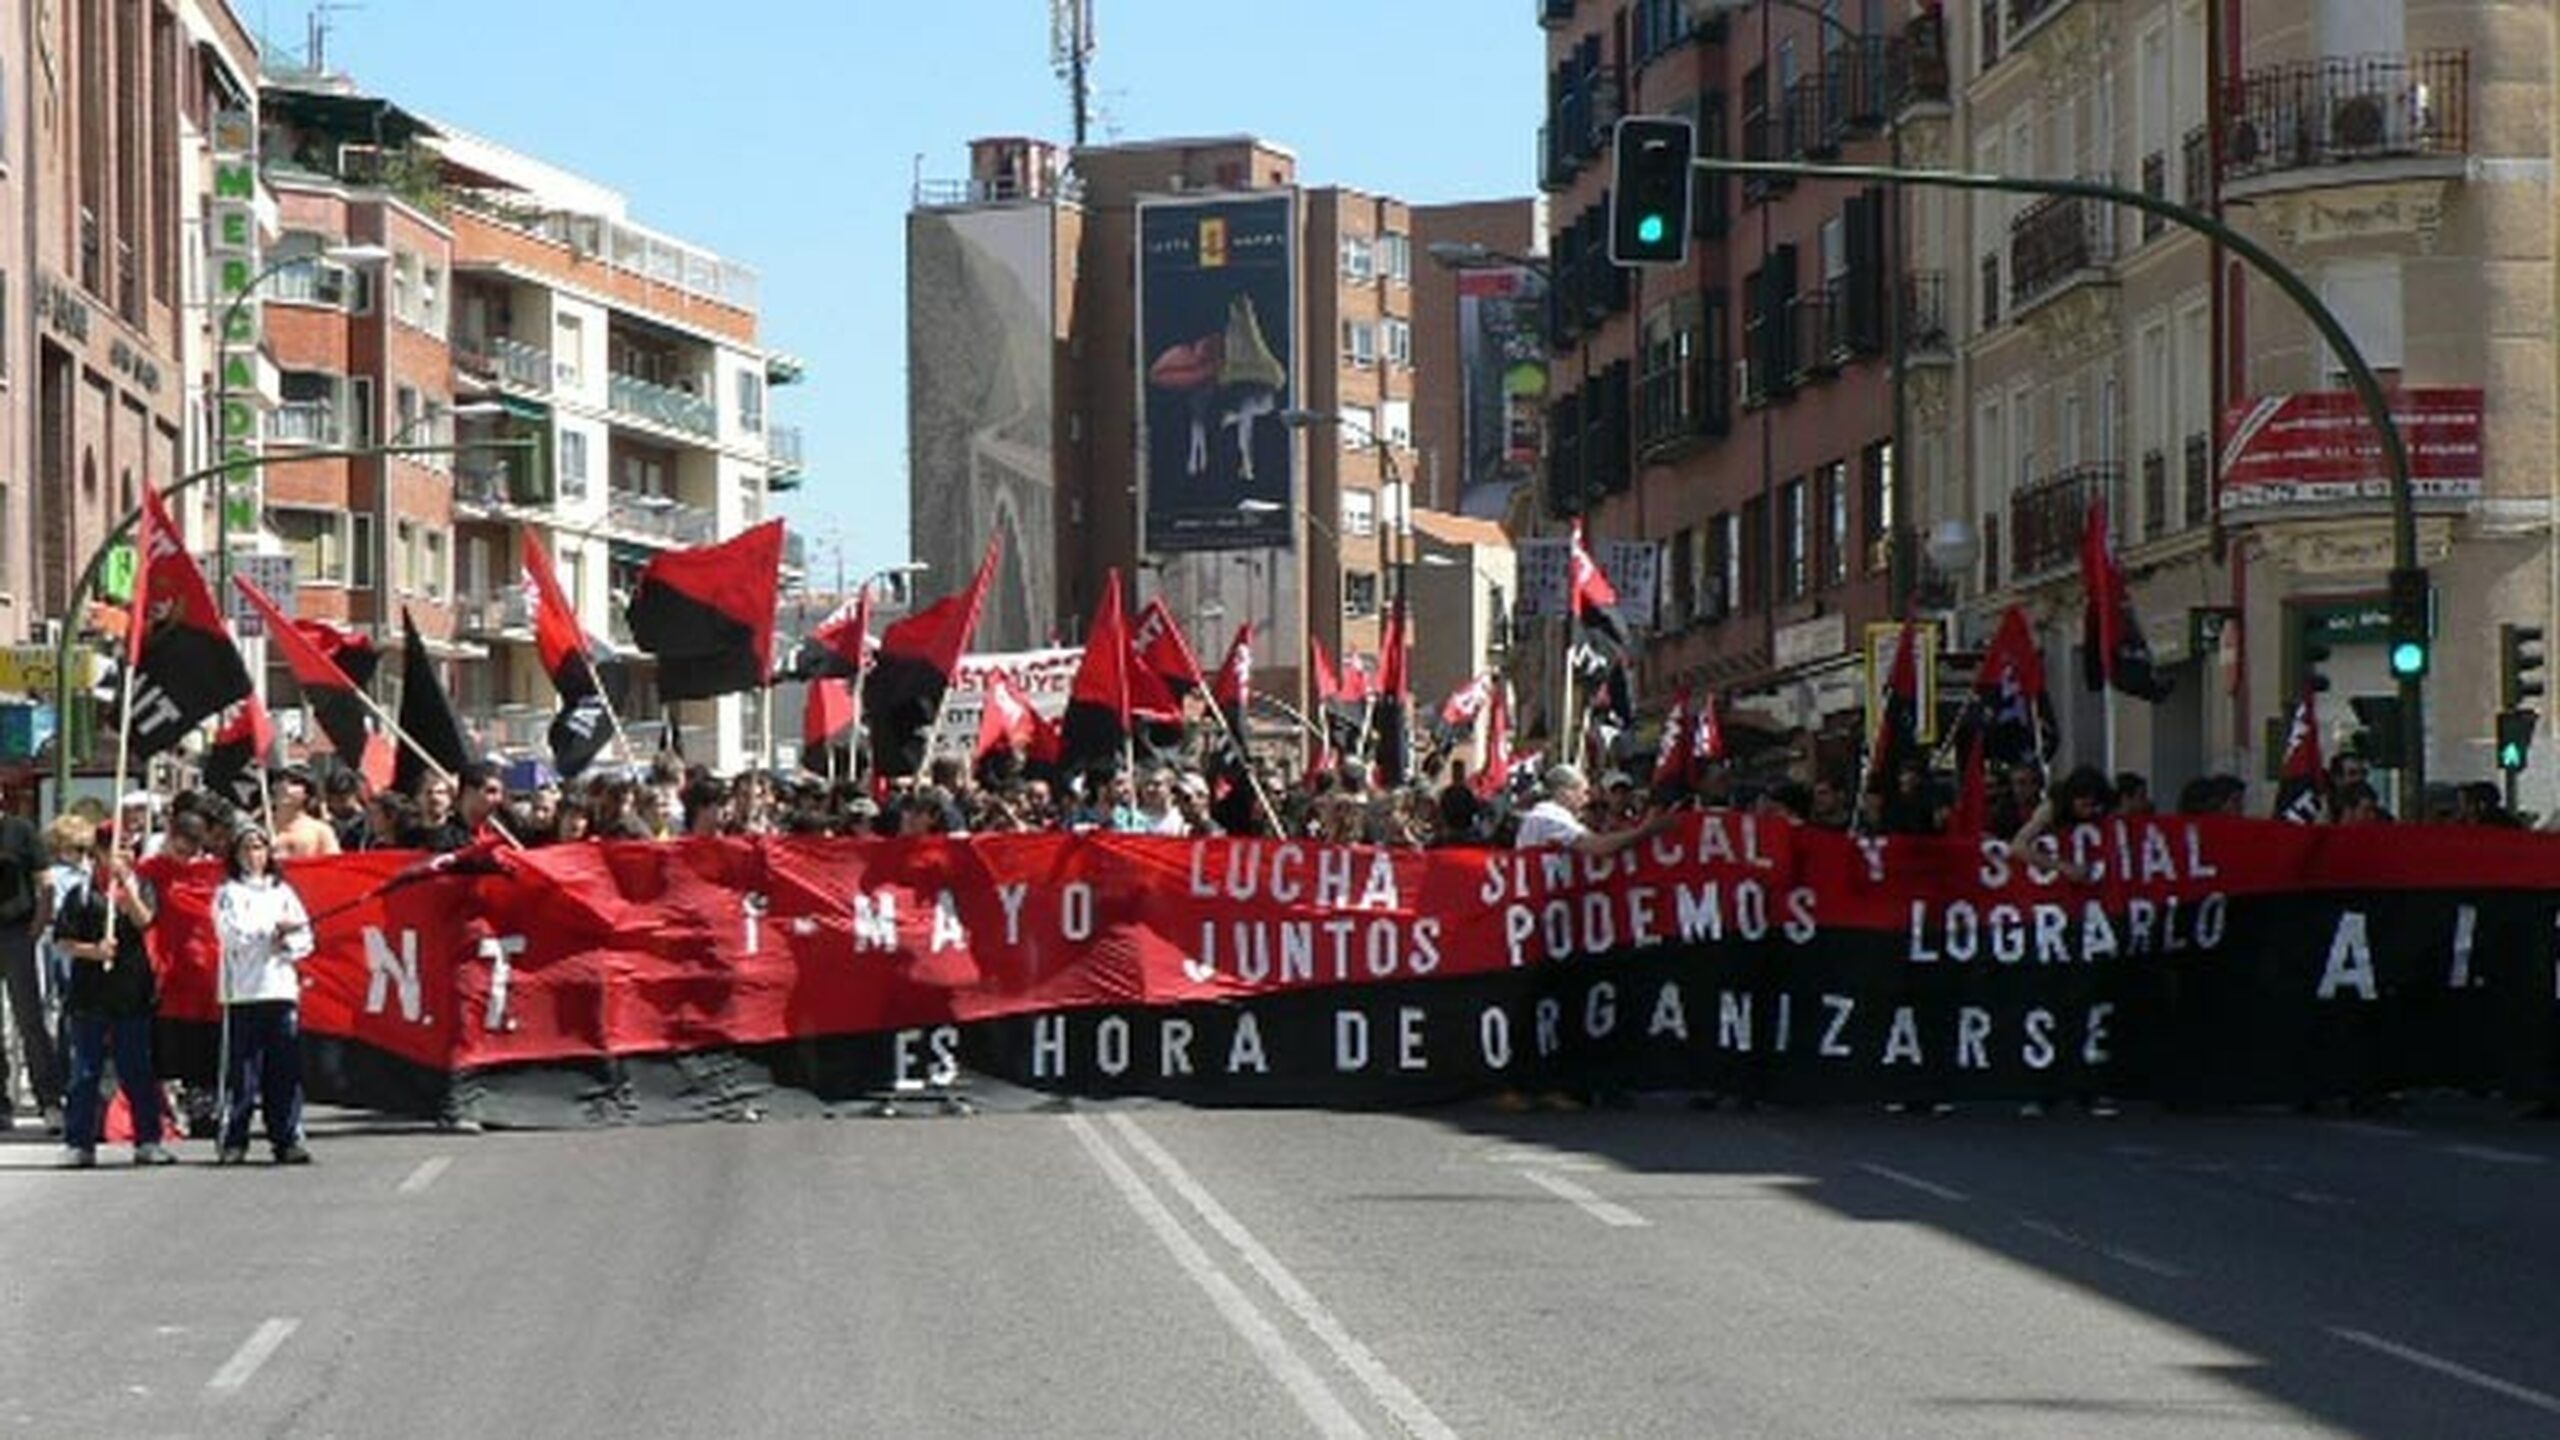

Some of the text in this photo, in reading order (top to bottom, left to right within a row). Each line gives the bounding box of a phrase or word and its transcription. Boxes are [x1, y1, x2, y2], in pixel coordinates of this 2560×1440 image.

[1190, 841, 1400, 911] LUCHA
[1857, 837, 1888, 881] Y
[1980, 819, 2217, 887] SOCIAL
[853, 881, 1092, 954] MAYO
[1183, 879, 2227, 983] JUNTOS PODEMOS LOGRARLO
[894, 981, 2115, 1091] ES HORA DE ORGANIZARSE
